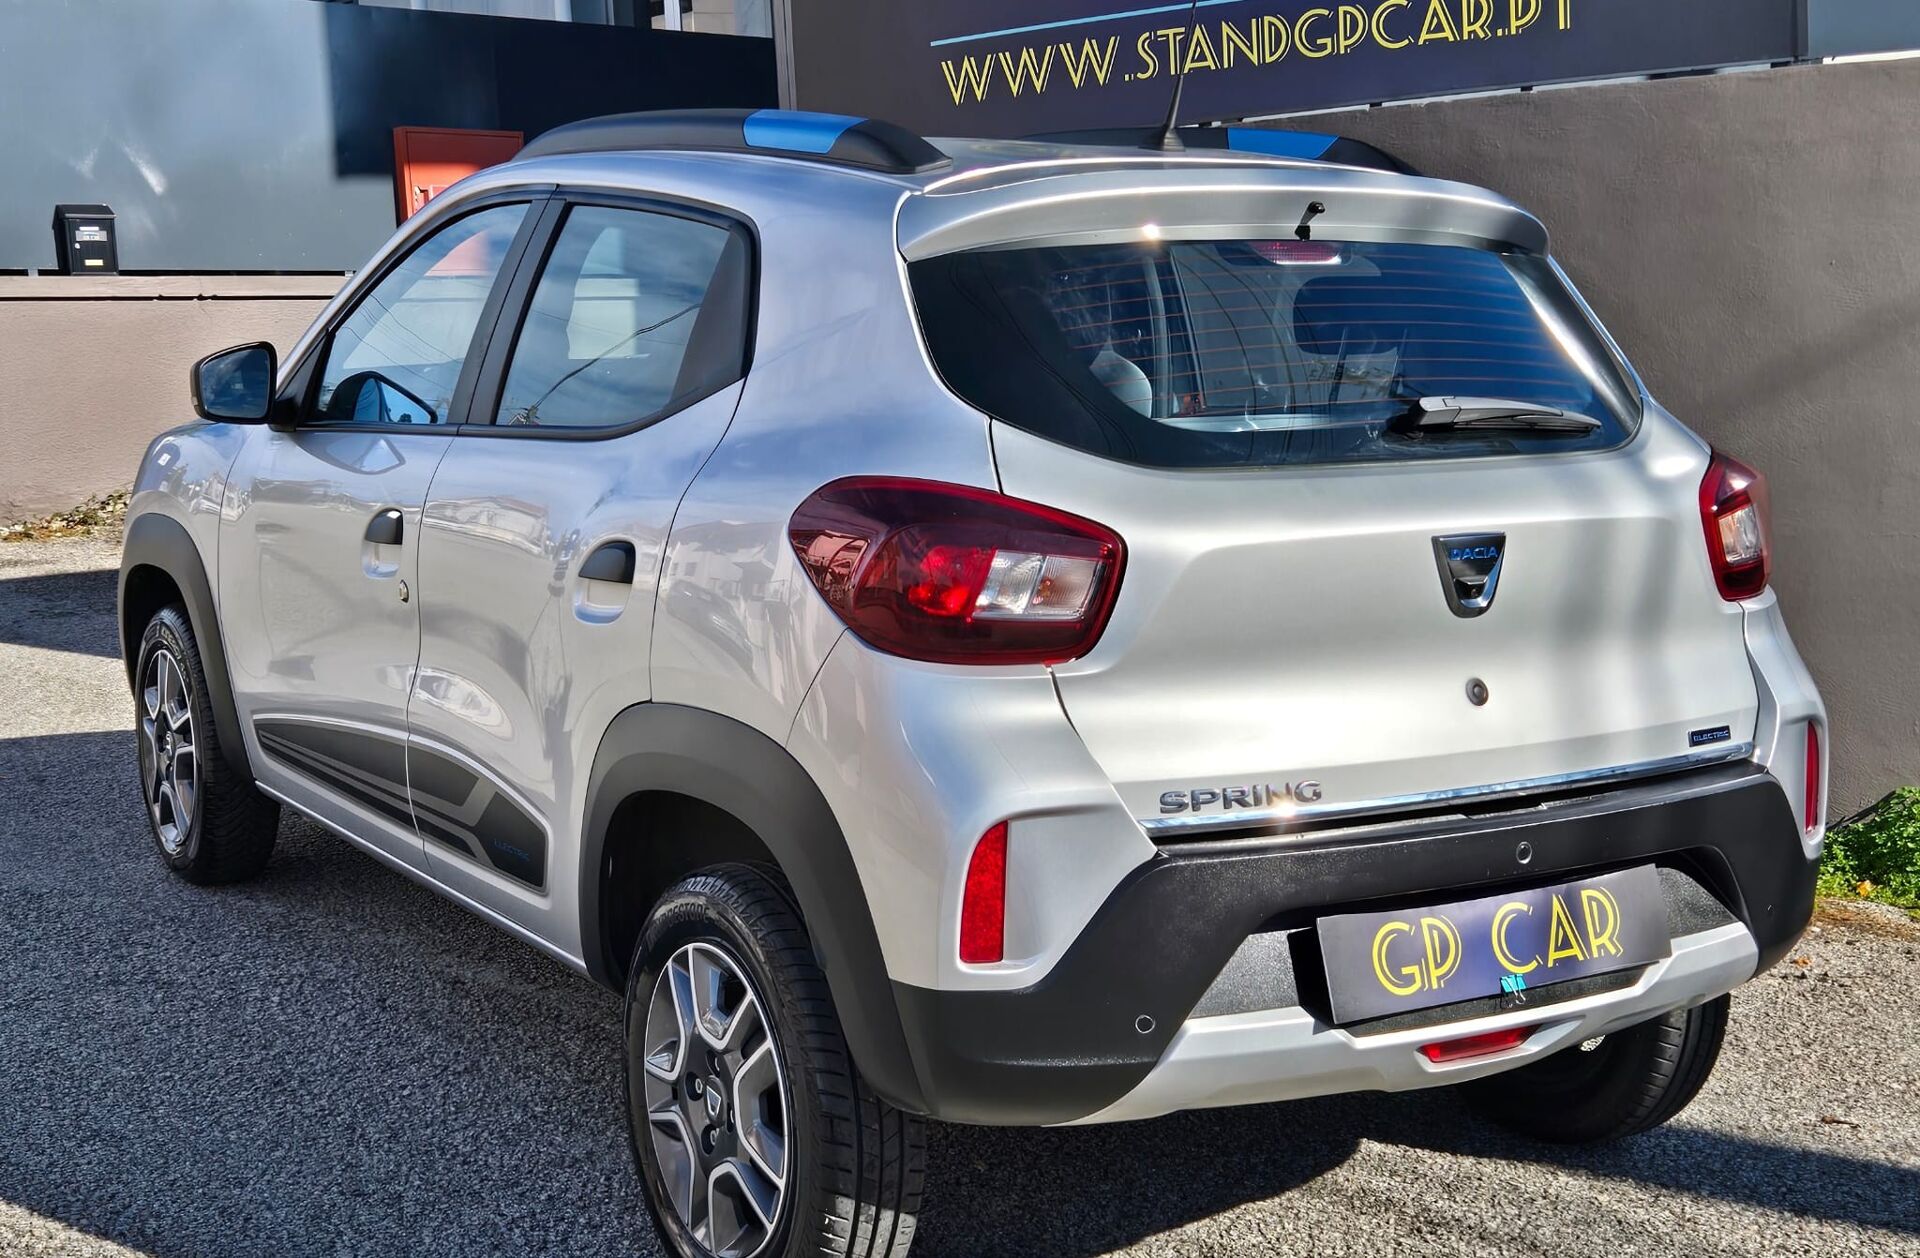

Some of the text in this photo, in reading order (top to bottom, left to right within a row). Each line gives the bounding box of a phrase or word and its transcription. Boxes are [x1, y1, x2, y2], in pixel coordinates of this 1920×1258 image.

[1450, 546, 1498, 560] DACIA
[1159, 780, 1322, 814] SPRING
[1372, 886, 1624, 996] GP CAR
